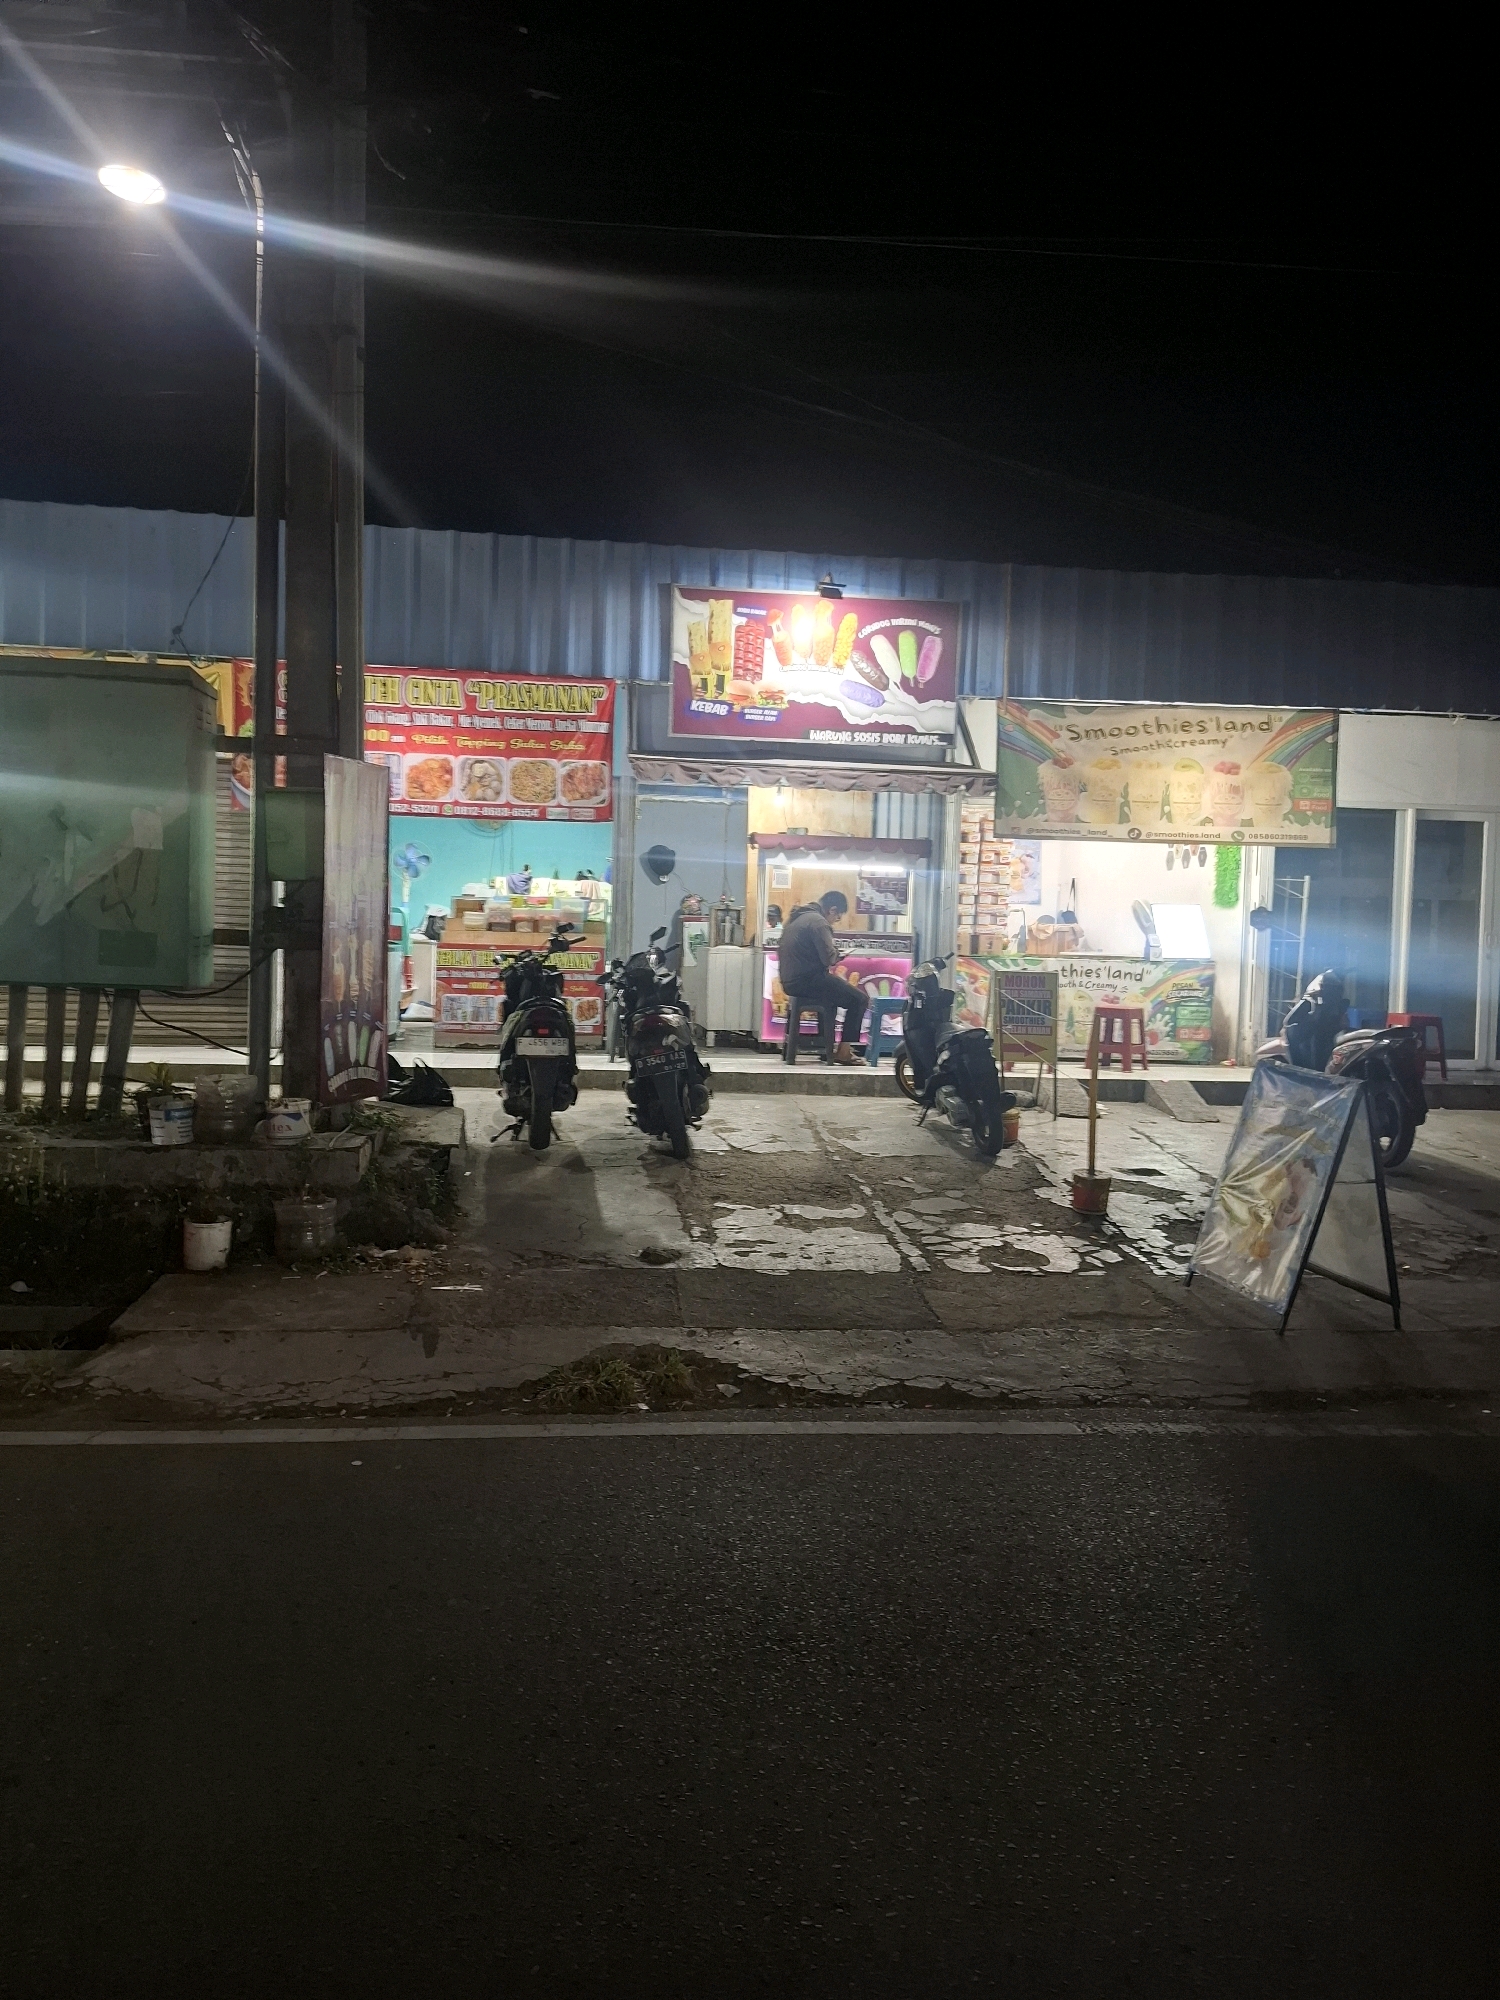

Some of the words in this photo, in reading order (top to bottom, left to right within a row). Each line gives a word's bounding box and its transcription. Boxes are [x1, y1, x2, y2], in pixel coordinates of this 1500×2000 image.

[406, 676, 461, 707] CINTA
[467, 680, 605, 713] "PRASMANAN"
[690, 701, 729, 716] KEBAB
[453, 736, 505, 749] Topping
[809, 729, 852, 742] WARUNG
[853, 731, 881, 743] SOSIS
[1145, 831, 1221, 840] @smoothies.land
[1004, 975, 1046, 989] MOHON
[1085, 980, 1118, 993] Creamy
[1000, 998, 1052, 1017] PARKIR
[1003, 1015, 1046, 1026] SMOOTHIES
